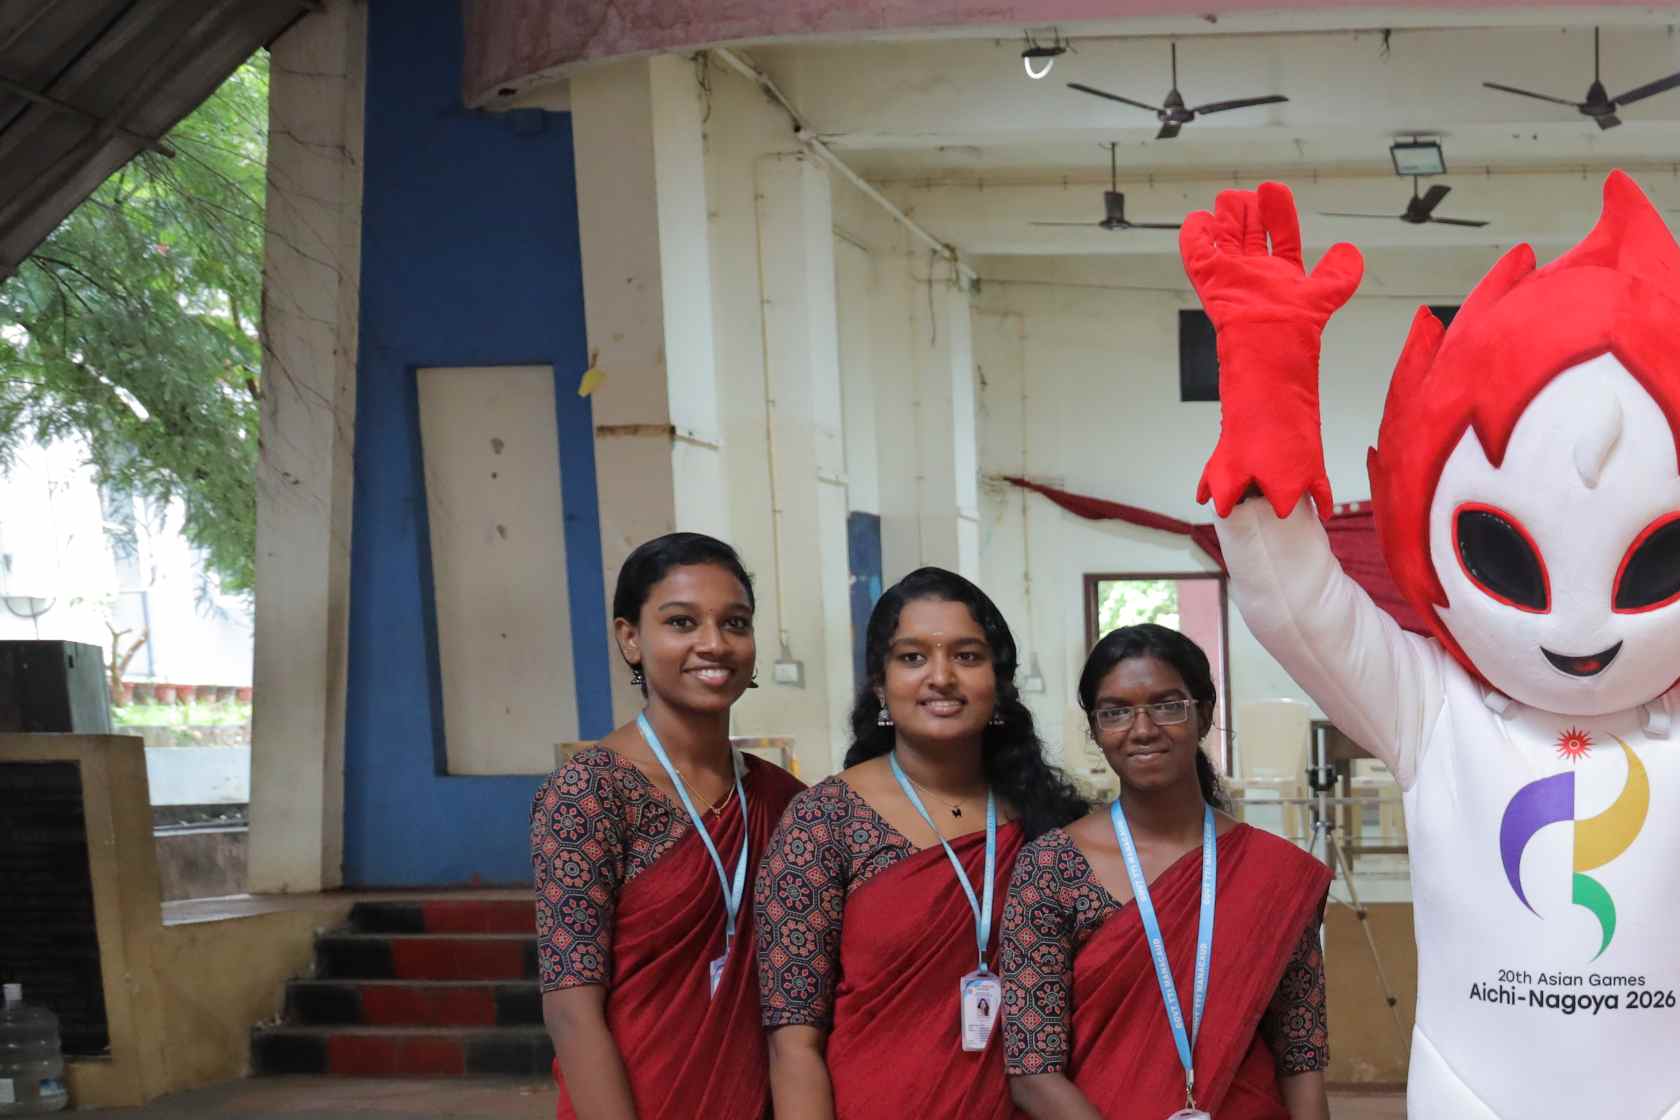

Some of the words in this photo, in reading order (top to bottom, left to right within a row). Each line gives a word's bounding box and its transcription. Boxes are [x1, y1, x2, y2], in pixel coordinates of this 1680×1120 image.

[1498, 969, 1532, 985] 20th
[1537, 972, 1583, 986] Asian
[1588, 973, 1646, 986] Games
[1469, 982, 1619, 1016] Aichi-Nagoya
[1625, 990, 1677, 1009] 2026
